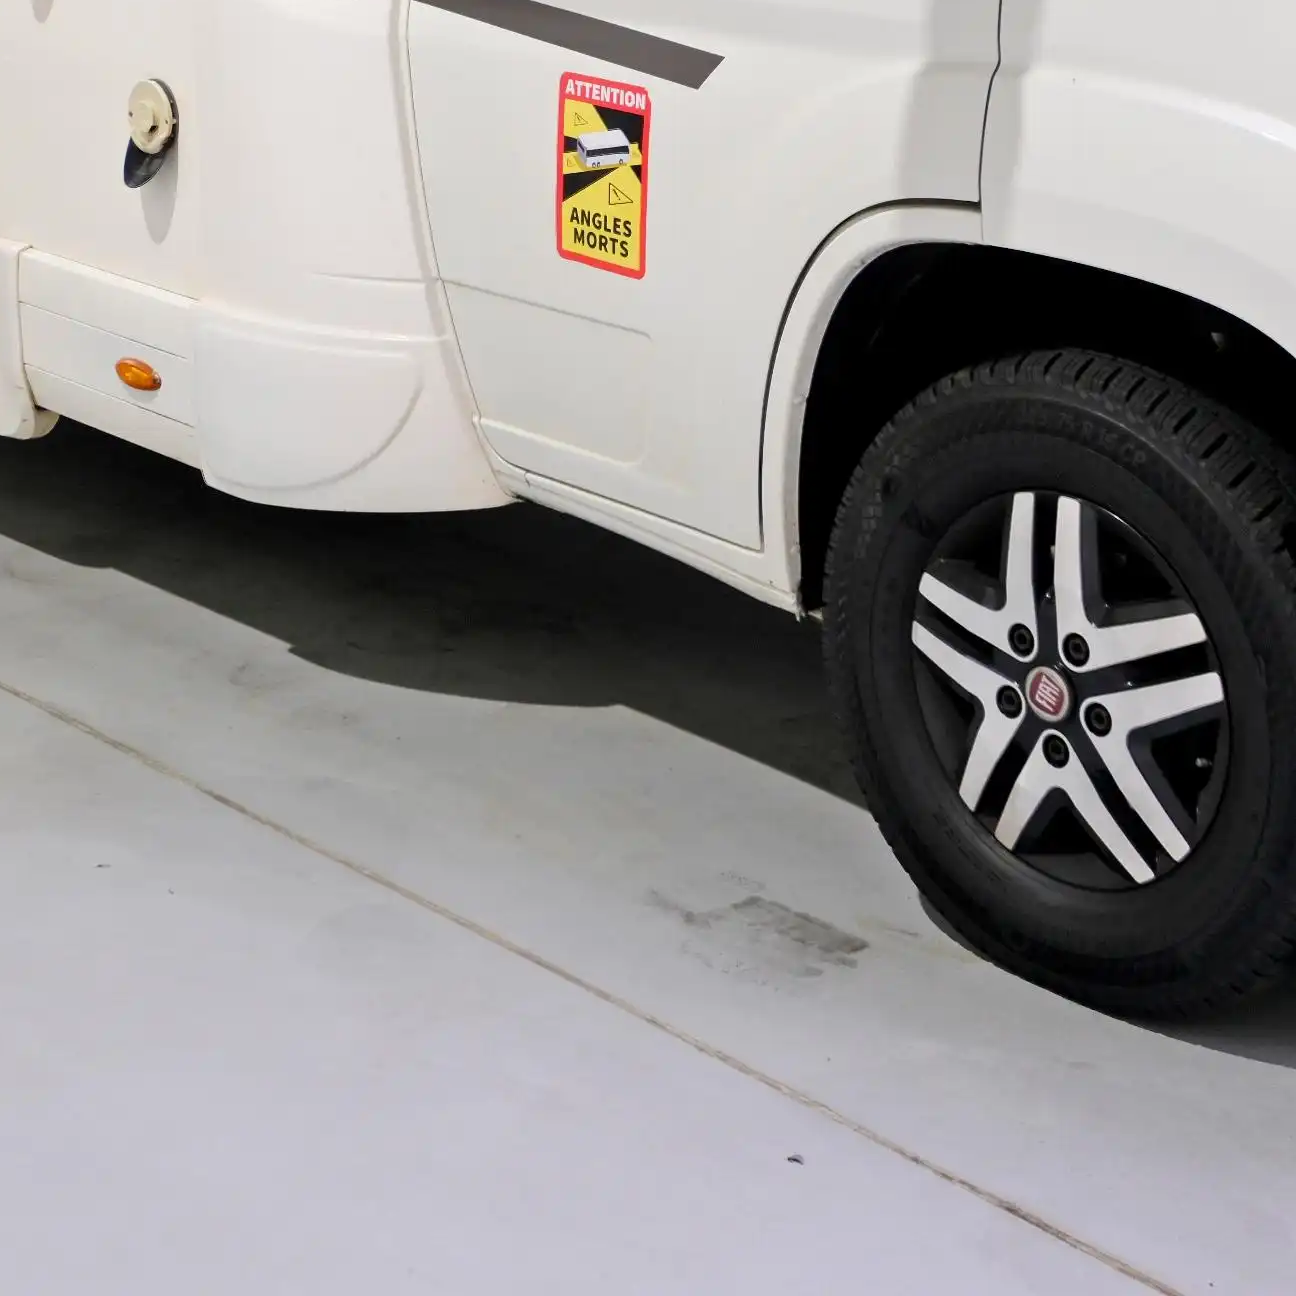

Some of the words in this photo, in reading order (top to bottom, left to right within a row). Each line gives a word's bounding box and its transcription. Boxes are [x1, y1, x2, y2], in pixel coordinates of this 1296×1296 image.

[565, 79, 647, 111] ATTENTION
[570, 207, 632, 238] ANGLES
[573, 227, 629, 258] MORTS
[1035, 674, 1060, 712] FIAT
